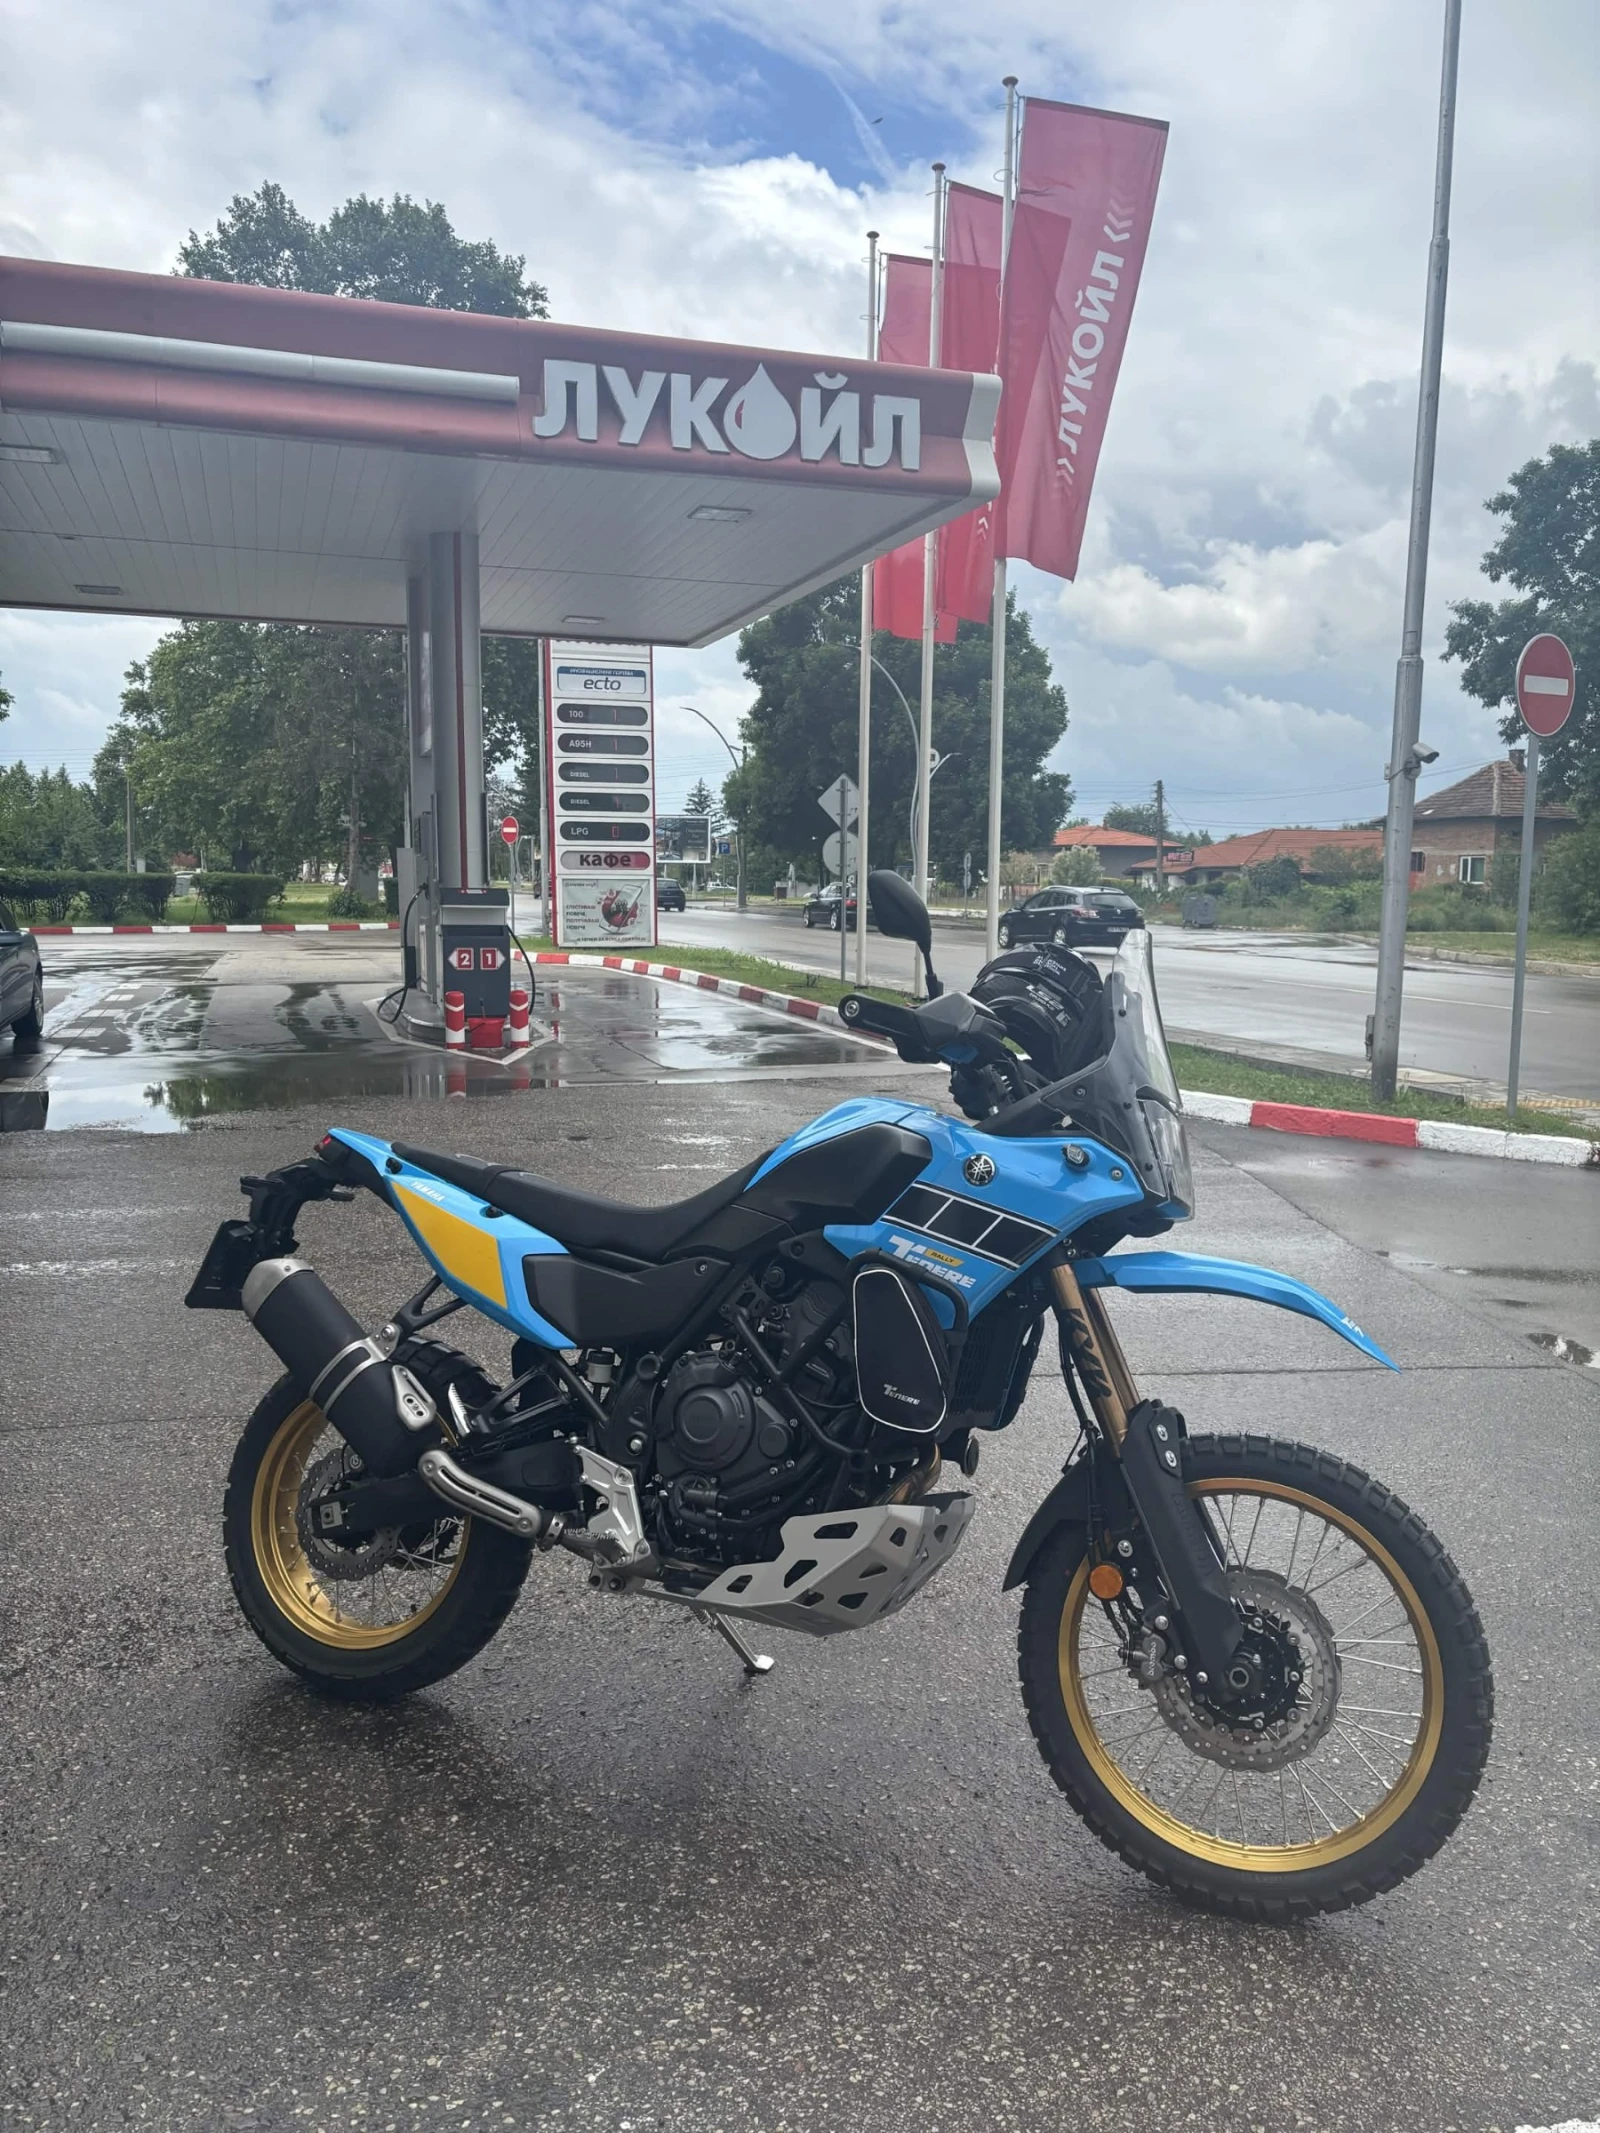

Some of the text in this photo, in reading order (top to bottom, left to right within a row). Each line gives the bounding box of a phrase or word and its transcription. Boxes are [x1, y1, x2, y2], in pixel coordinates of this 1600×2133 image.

[1057, 250, 1126, 455] ЛУКОЙЛ
[532, 358, 921, 471] ЛУКОЙЛ
[583, 676, 621, 690] ecto
[568, 710, 584, 718] 100
[570, 827, 589, 836] LPG
[579, 852, 632, 868] кафе
[460, 953, 470, 965] 2
[485, 953, 492, 964] 1
[929, 1249, 955, 1264] RALLY
[1147, 1641, 1157, 1676] brembo
